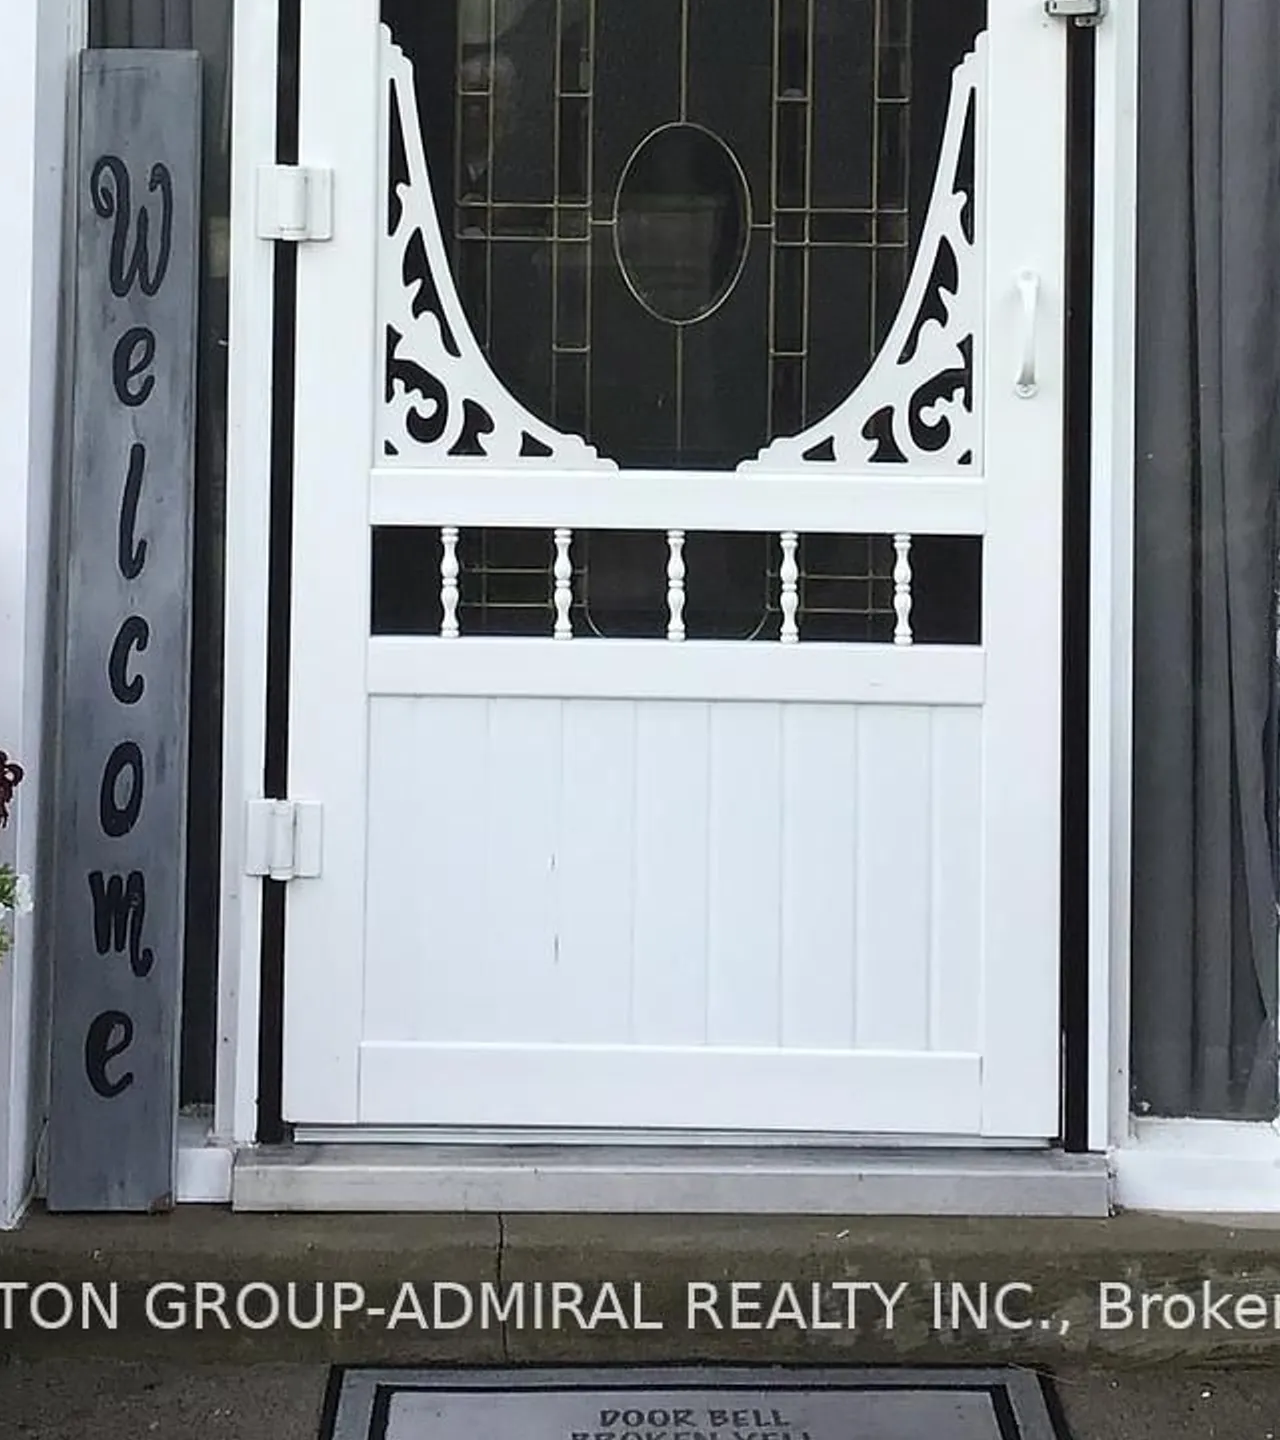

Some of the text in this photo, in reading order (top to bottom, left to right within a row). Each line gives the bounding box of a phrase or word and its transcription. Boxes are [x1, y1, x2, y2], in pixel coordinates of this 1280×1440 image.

[84, 154, 173, 1098] Welcome
[599, 1408, 791, 1428] DOOR BELL
